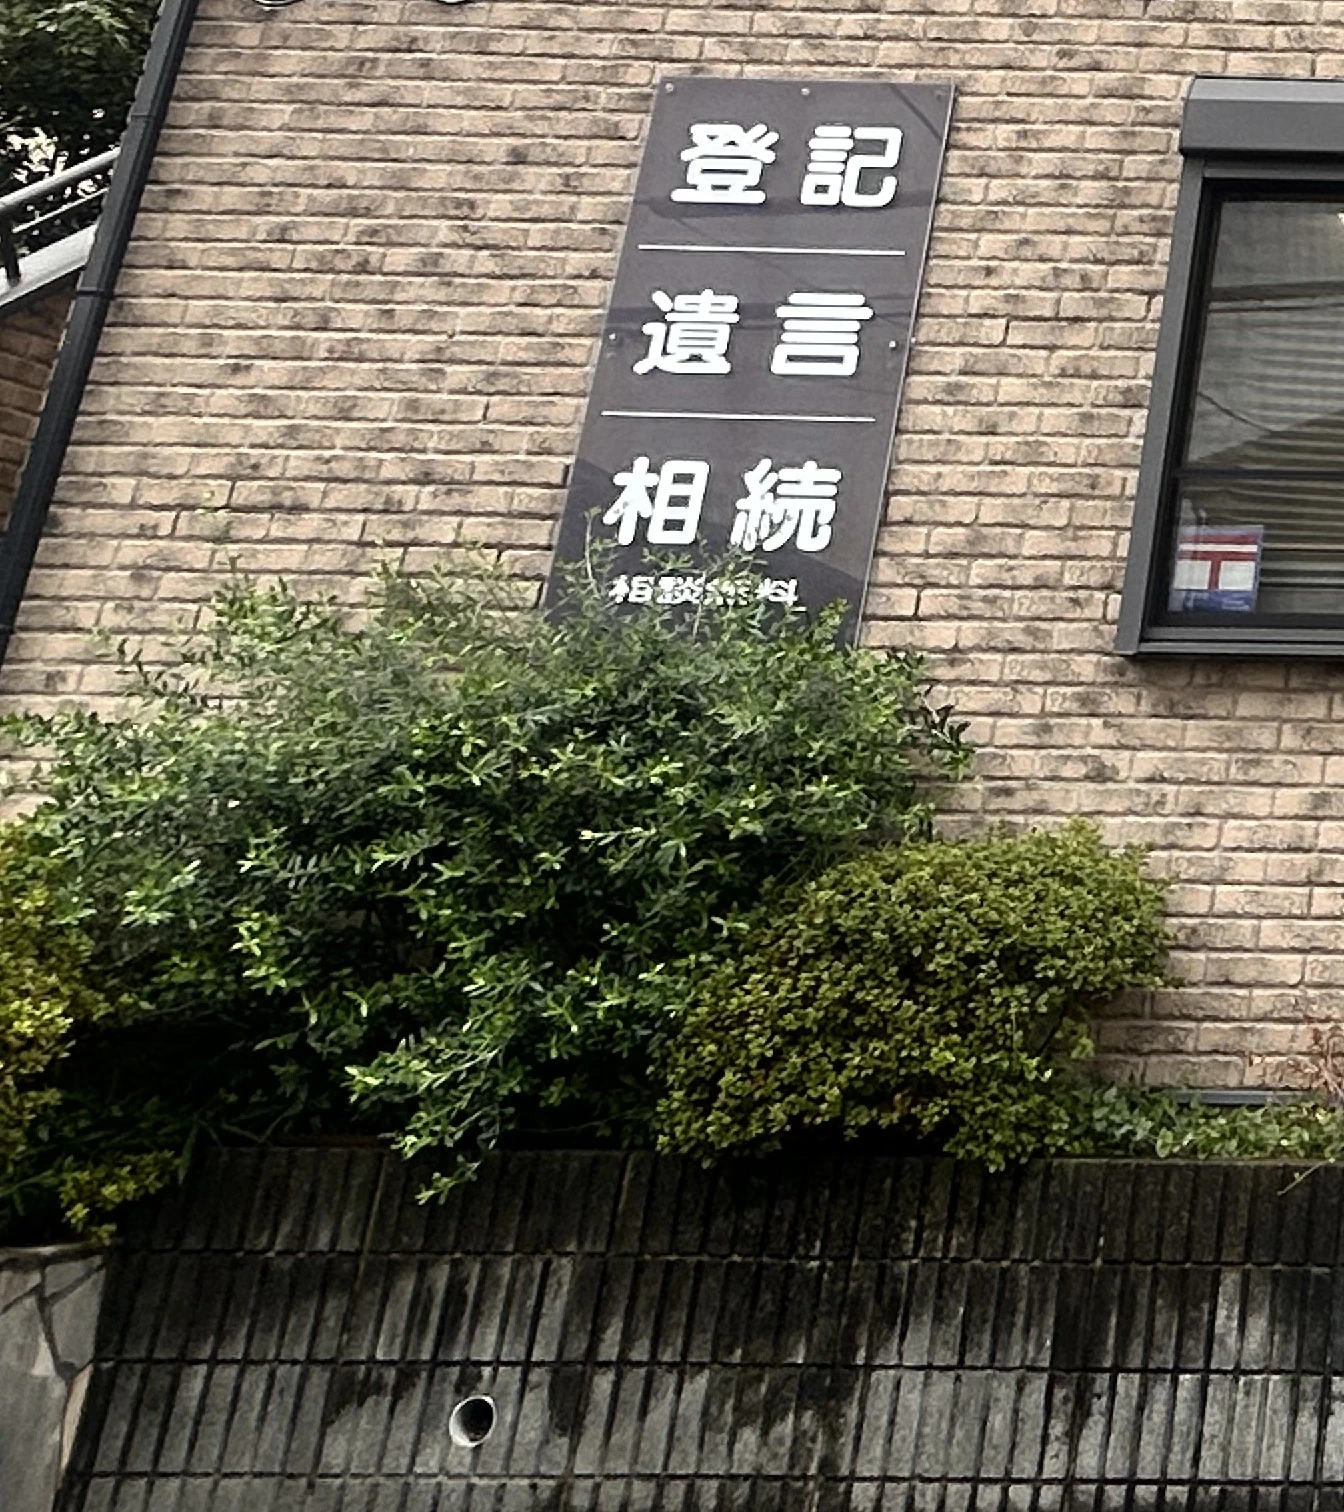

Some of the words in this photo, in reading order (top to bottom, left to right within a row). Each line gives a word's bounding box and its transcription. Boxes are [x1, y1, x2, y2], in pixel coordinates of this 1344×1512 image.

[671, 123, 902, 207] 登記
[632, 288, 874, 376] 遺言
[603, 456, 842, 552] 相続
